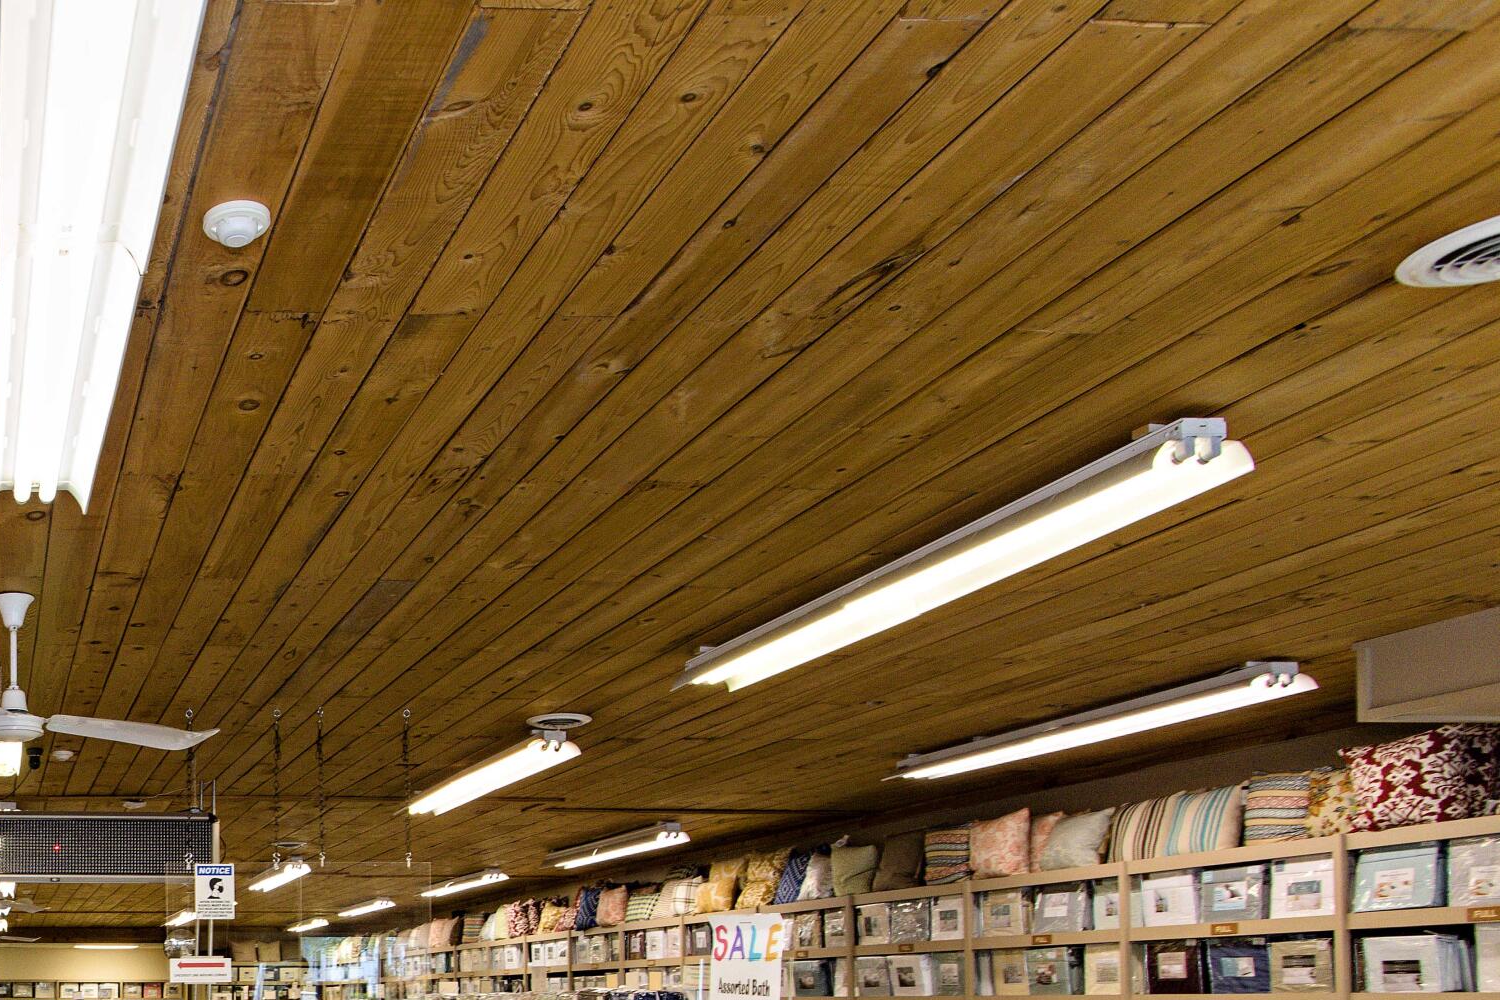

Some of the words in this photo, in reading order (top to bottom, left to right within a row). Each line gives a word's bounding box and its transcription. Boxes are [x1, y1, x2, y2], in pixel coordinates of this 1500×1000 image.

[198, 867, 231, 875] NOTICE
[714, 923, 783, 962] SALE
[718, 977, 749, 996] Assorted
[752, 979, 770, 997] Bath
